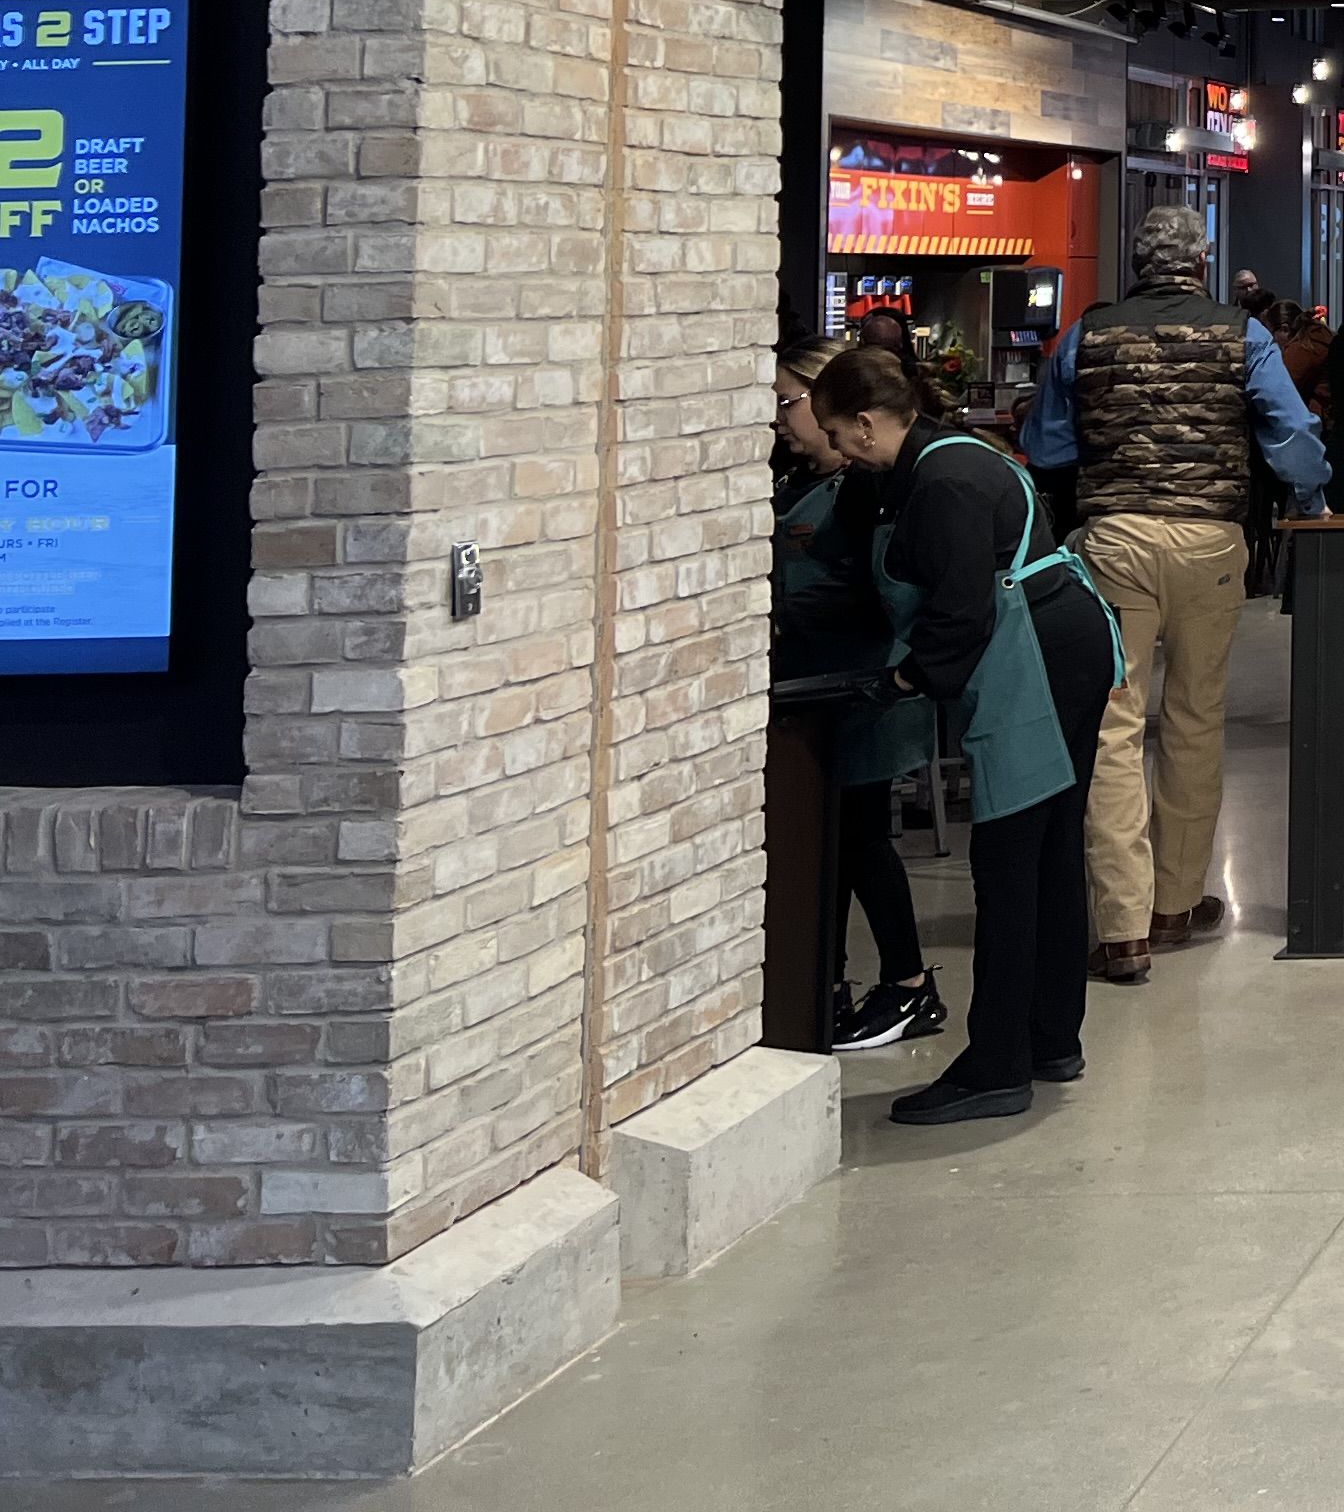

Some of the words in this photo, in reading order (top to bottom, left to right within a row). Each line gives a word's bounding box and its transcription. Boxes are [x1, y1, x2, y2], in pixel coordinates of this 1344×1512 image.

[35, 11, 72, 48] 2
[83, 7, 171, 46] STEP
[21, 59, 49, 70] ALL
[51, 58, 81, 69] DAY
[75, 137, 145, 155] DRAFT
[74, 157, 128, 175] BEER
[74, 178, 104, 194] OR
[859, 176, 961, 214] FIXIN'S
[72, 197, 158, 215] LOADED
[72, 216, 160, 236] NACHOS
[5, 479, 59, 499] FOR
